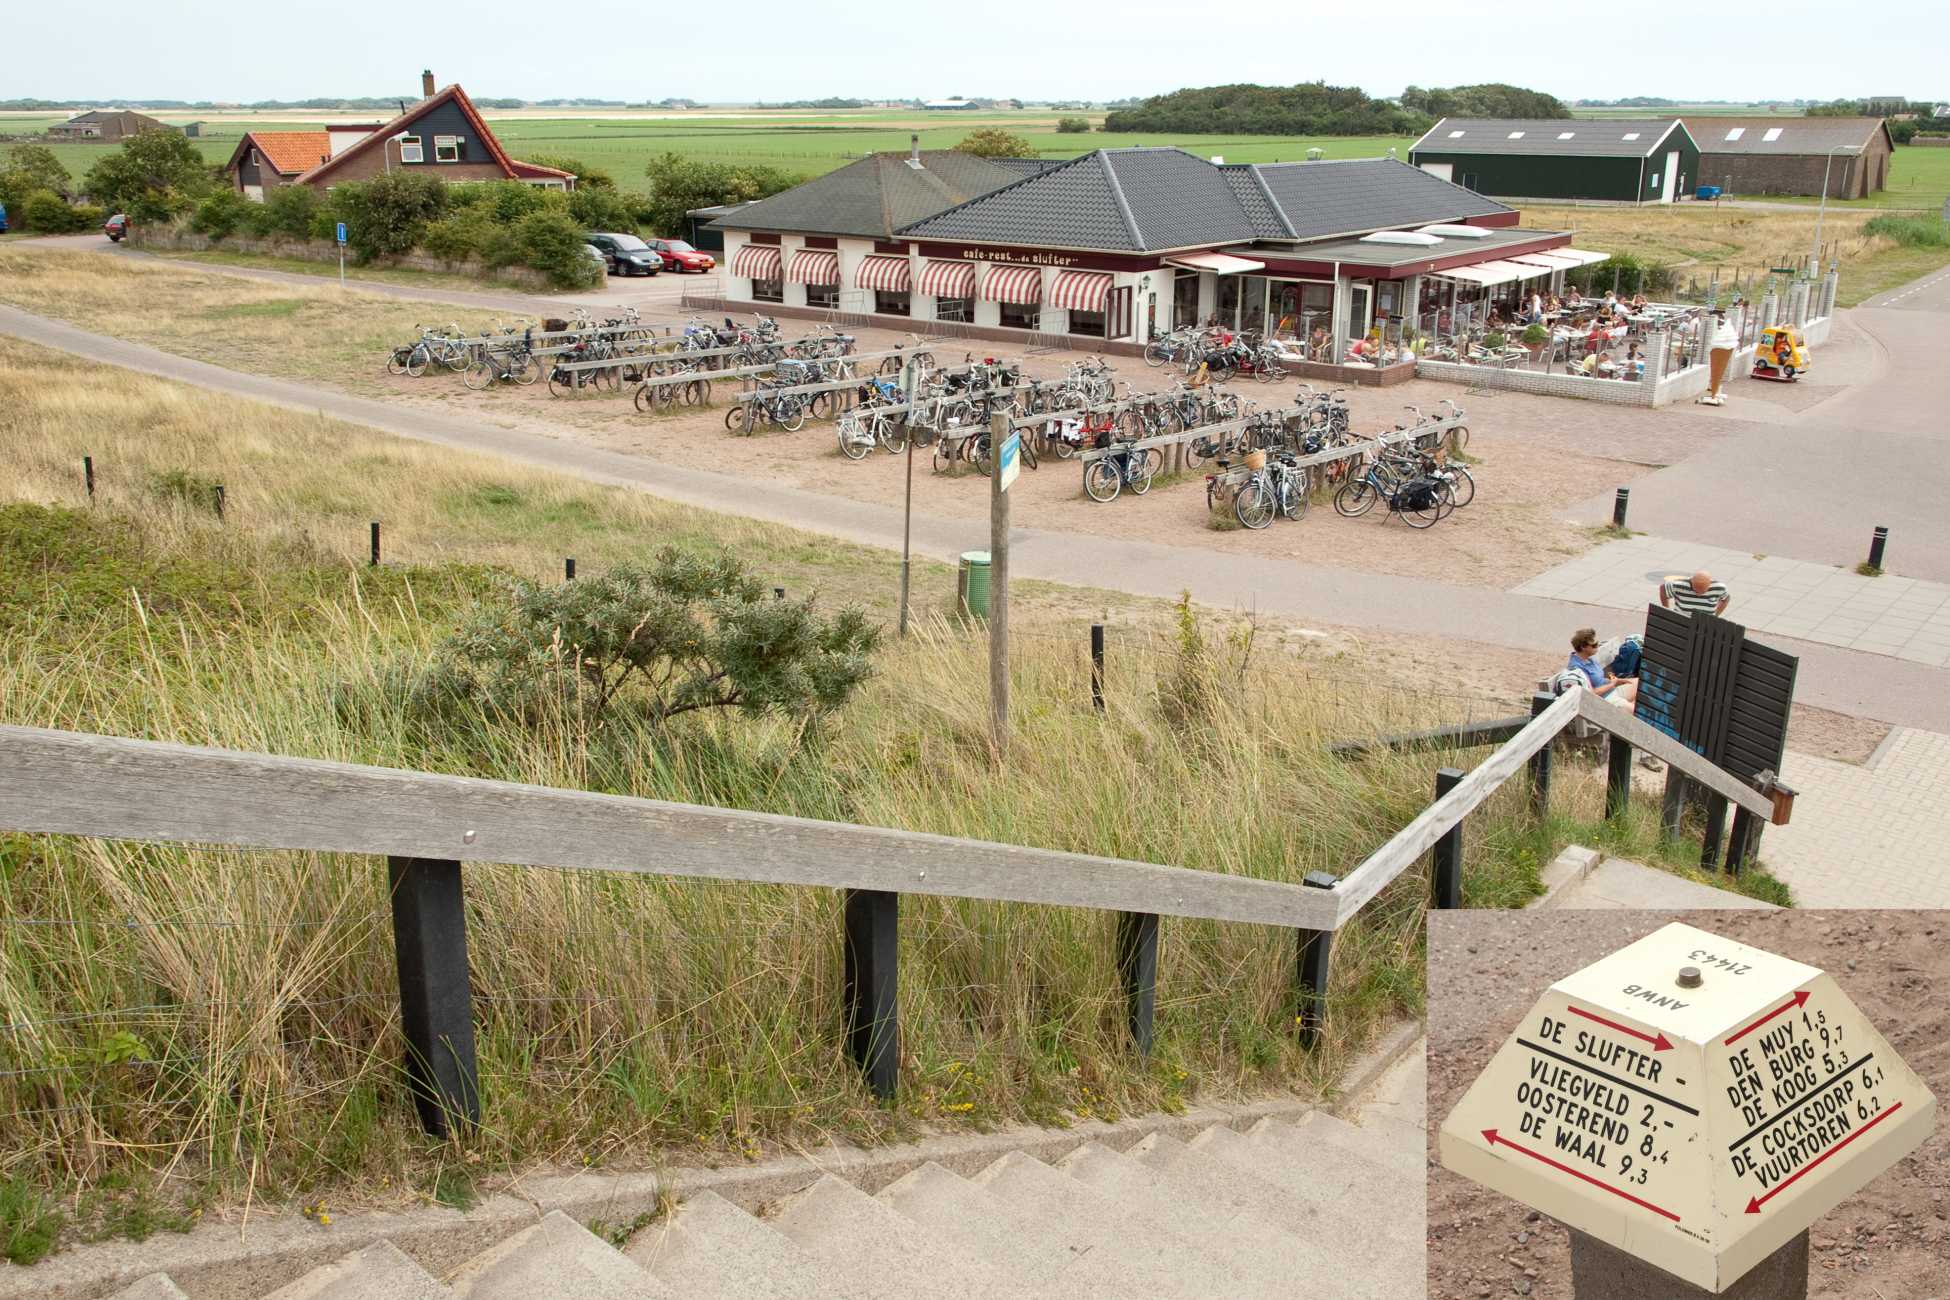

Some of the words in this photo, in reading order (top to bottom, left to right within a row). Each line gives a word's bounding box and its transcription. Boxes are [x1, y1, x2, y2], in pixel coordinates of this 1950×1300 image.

[1622, 984, 1691, 1011] ANWB
[1687, 949, 1753, 976] 21443
[1539, 1016, 1567, 1044] DE
[1575, 1030, 1663, 1083] SLUFTER
[1726, 1071, 1764, 1109] DEN
[1768, 1038, 1815, 1081] BURG
[1819, 1025, 1844, 1049] 9,7
[1728, 1047, 1756, 1078] DE
[1759, 1020, 1794, 1059] MUY
[1802, 1009, 1826, 1032] 1,5
[1517, 1082, 1630, 1146] OOSTEREND
[1639, 1134, 1670, 1165] 8,4
[1530, 1057, 1630, 1116] VLIEGVELD
[1731, 1146, 1757, 1178] DE
[1762, 1080, 1854, 1156] COCKSDORP
[1862, 1066, 1885, 1091] 6,1
[1742, 1097, 1768, 1128] DE
[1772, 1065, 1817, 1108] KOOG
[1822, 1050, 1849, 1075] 5,3
[1519, 1111, 1547, 1140] DE
[1555, 1125, 1607, 1168] WAAL
[1618, 1154, 1649, 1185] 9,3
[1754, 1110, 1852, 1189] VUURTOREN
[1857, 1096, 1881, 1121] 6,2
